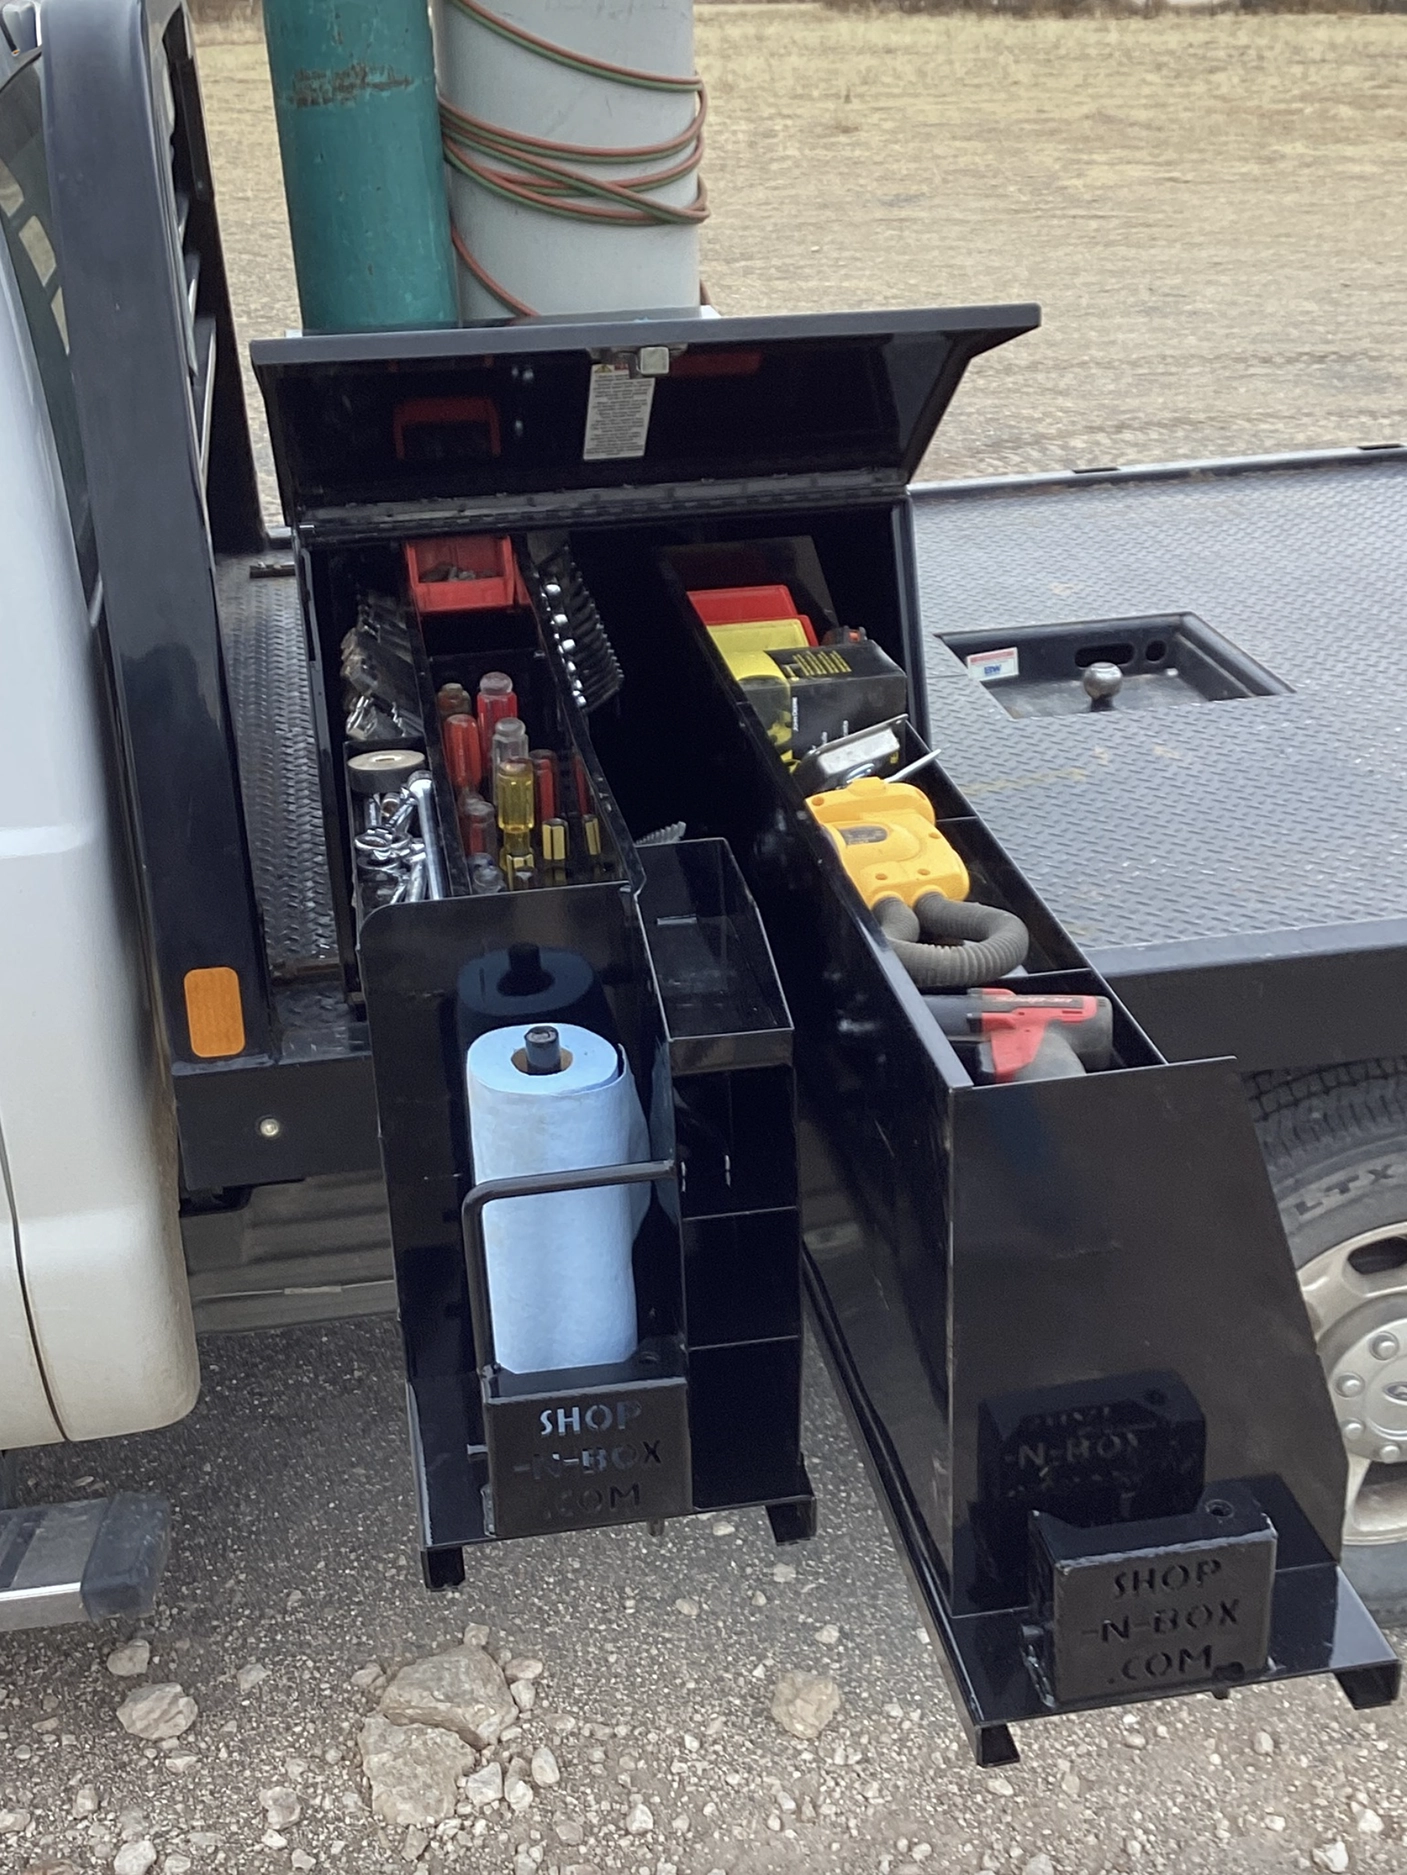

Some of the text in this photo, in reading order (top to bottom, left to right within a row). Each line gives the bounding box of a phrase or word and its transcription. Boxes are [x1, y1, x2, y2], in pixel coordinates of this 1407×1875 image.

[1294, 1164, 1396, 1215] LTX
[539, 1400, 642, 1436] SHOP
[1114, 1559, 1222, 1599] SHOP
[1081, 1599, 1240, 1643] -N-BOX
[1107, 1644, 1213, 1685] .COM
